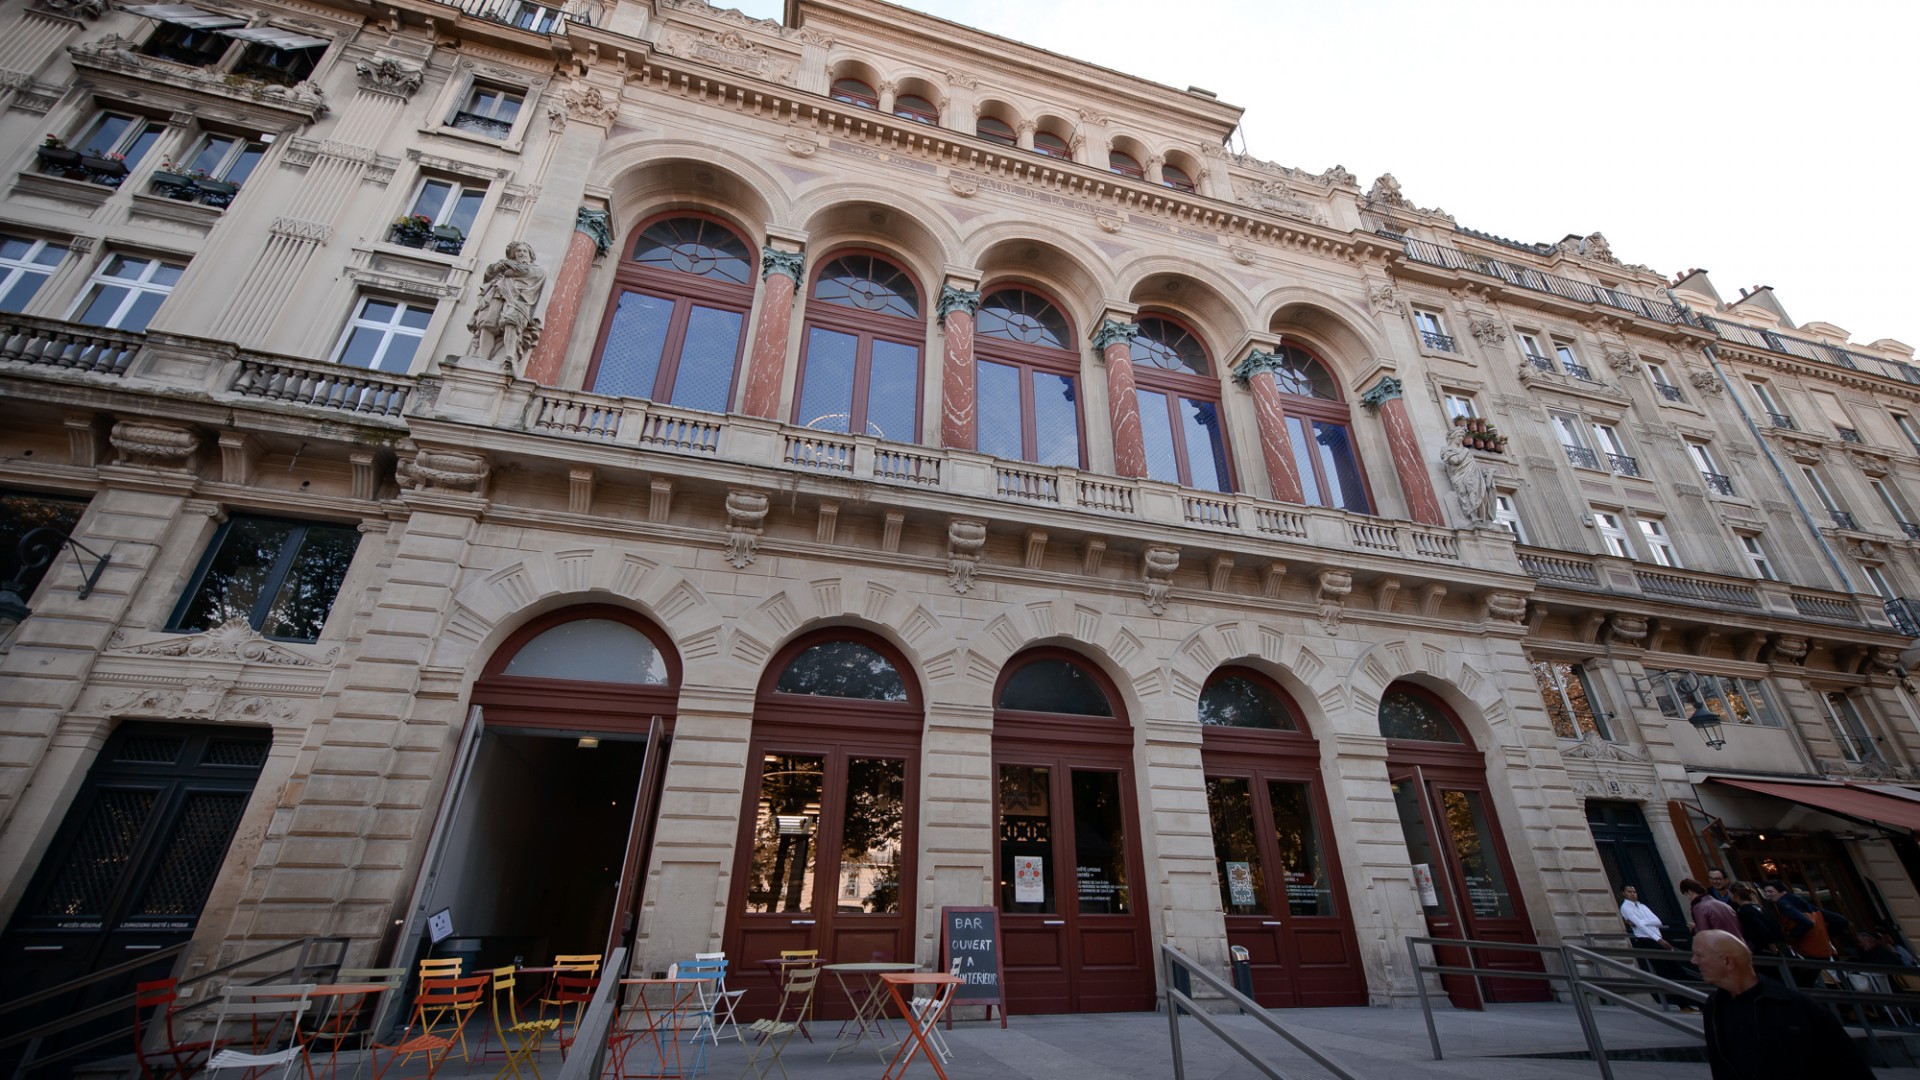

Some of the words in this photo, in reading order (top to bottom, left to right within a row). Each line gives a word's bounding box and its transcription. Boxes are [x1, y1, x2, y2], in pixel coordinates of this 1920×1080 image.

[1025, 189, 1041, 201] DE
[1049, 196, 1065, 207] LA
[955, 917, 983, 930] BAR
[952, 939, 993, 951] OUVERT
